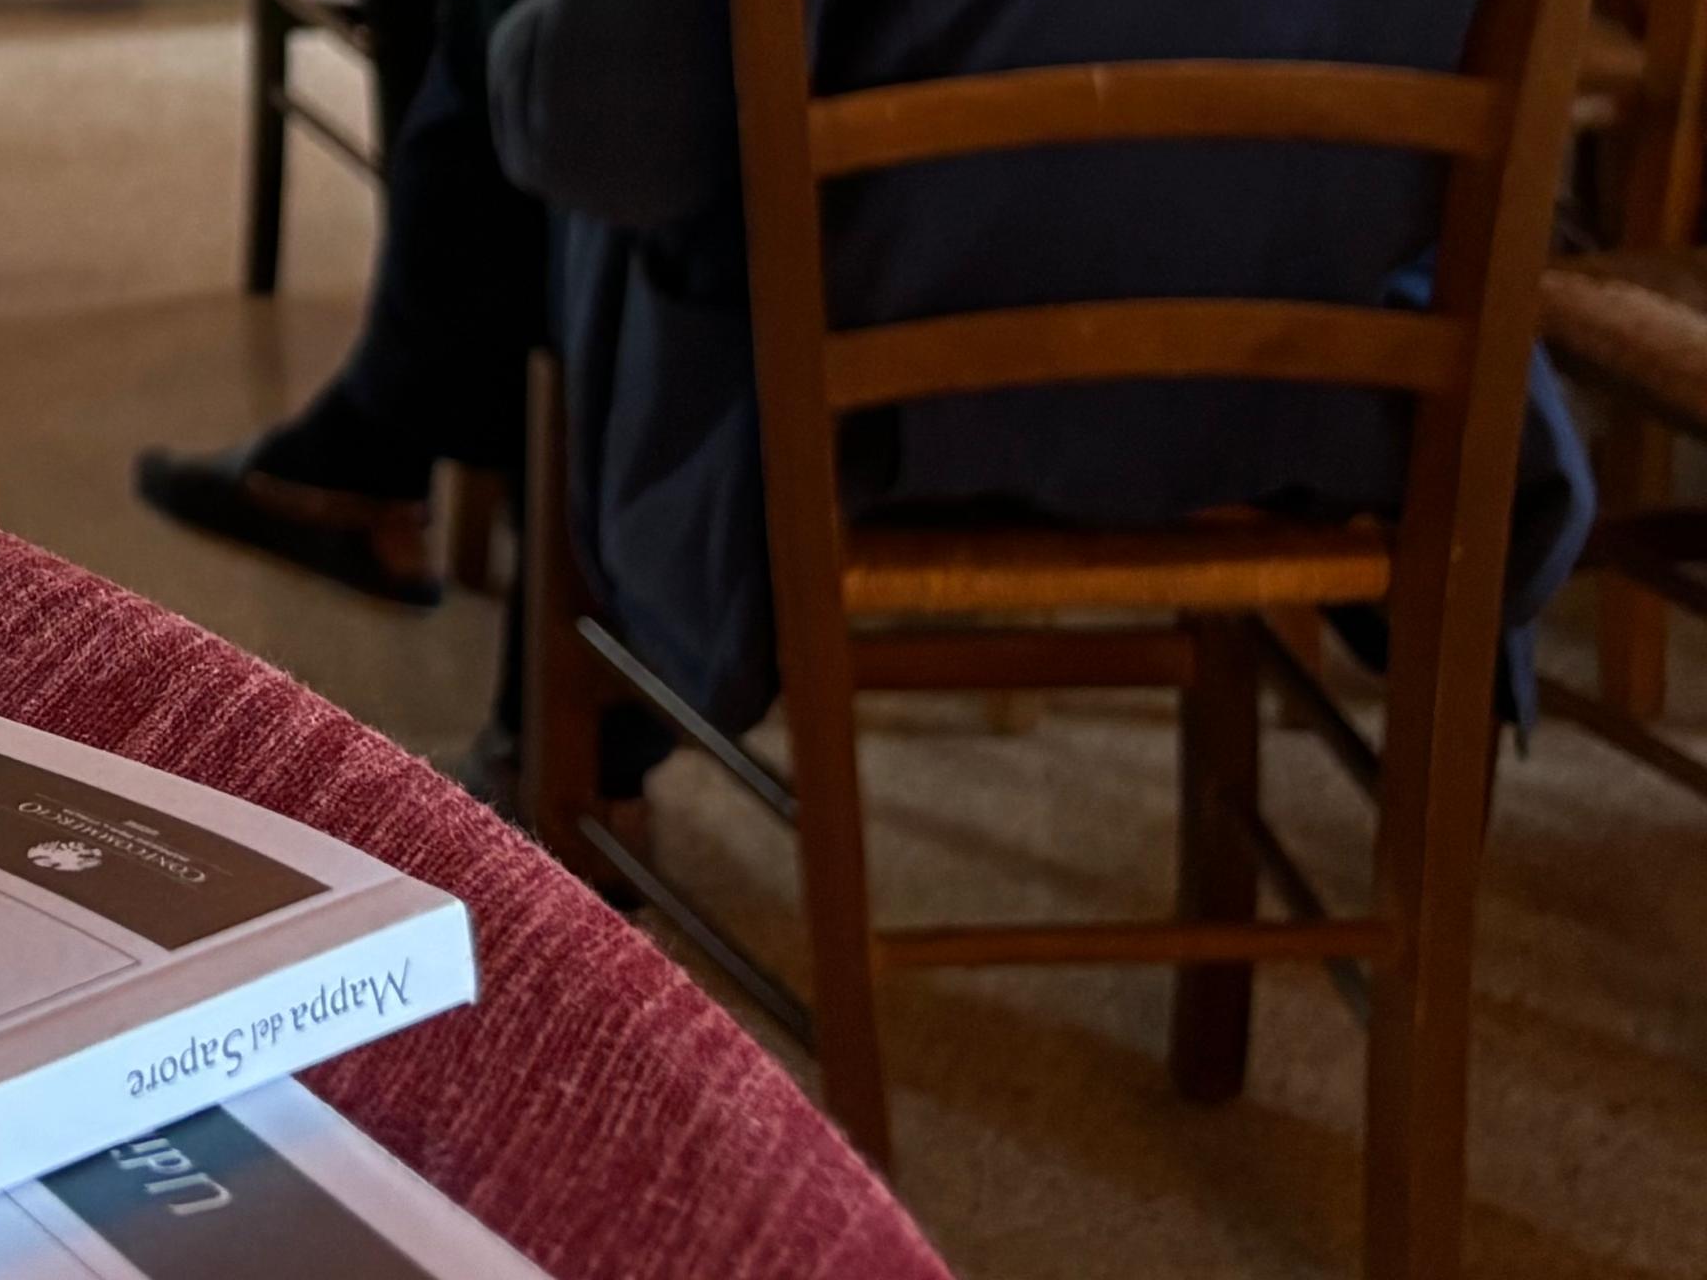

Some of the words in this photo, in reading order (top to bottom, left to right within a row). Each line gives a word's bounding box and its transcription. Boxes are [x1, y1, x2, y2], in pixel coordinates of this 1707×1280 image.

[289, 956, 411, 1032] Mappa
[126, 1028, 245, 1097] Sapore
[251, 1011, 284, 1051] del
